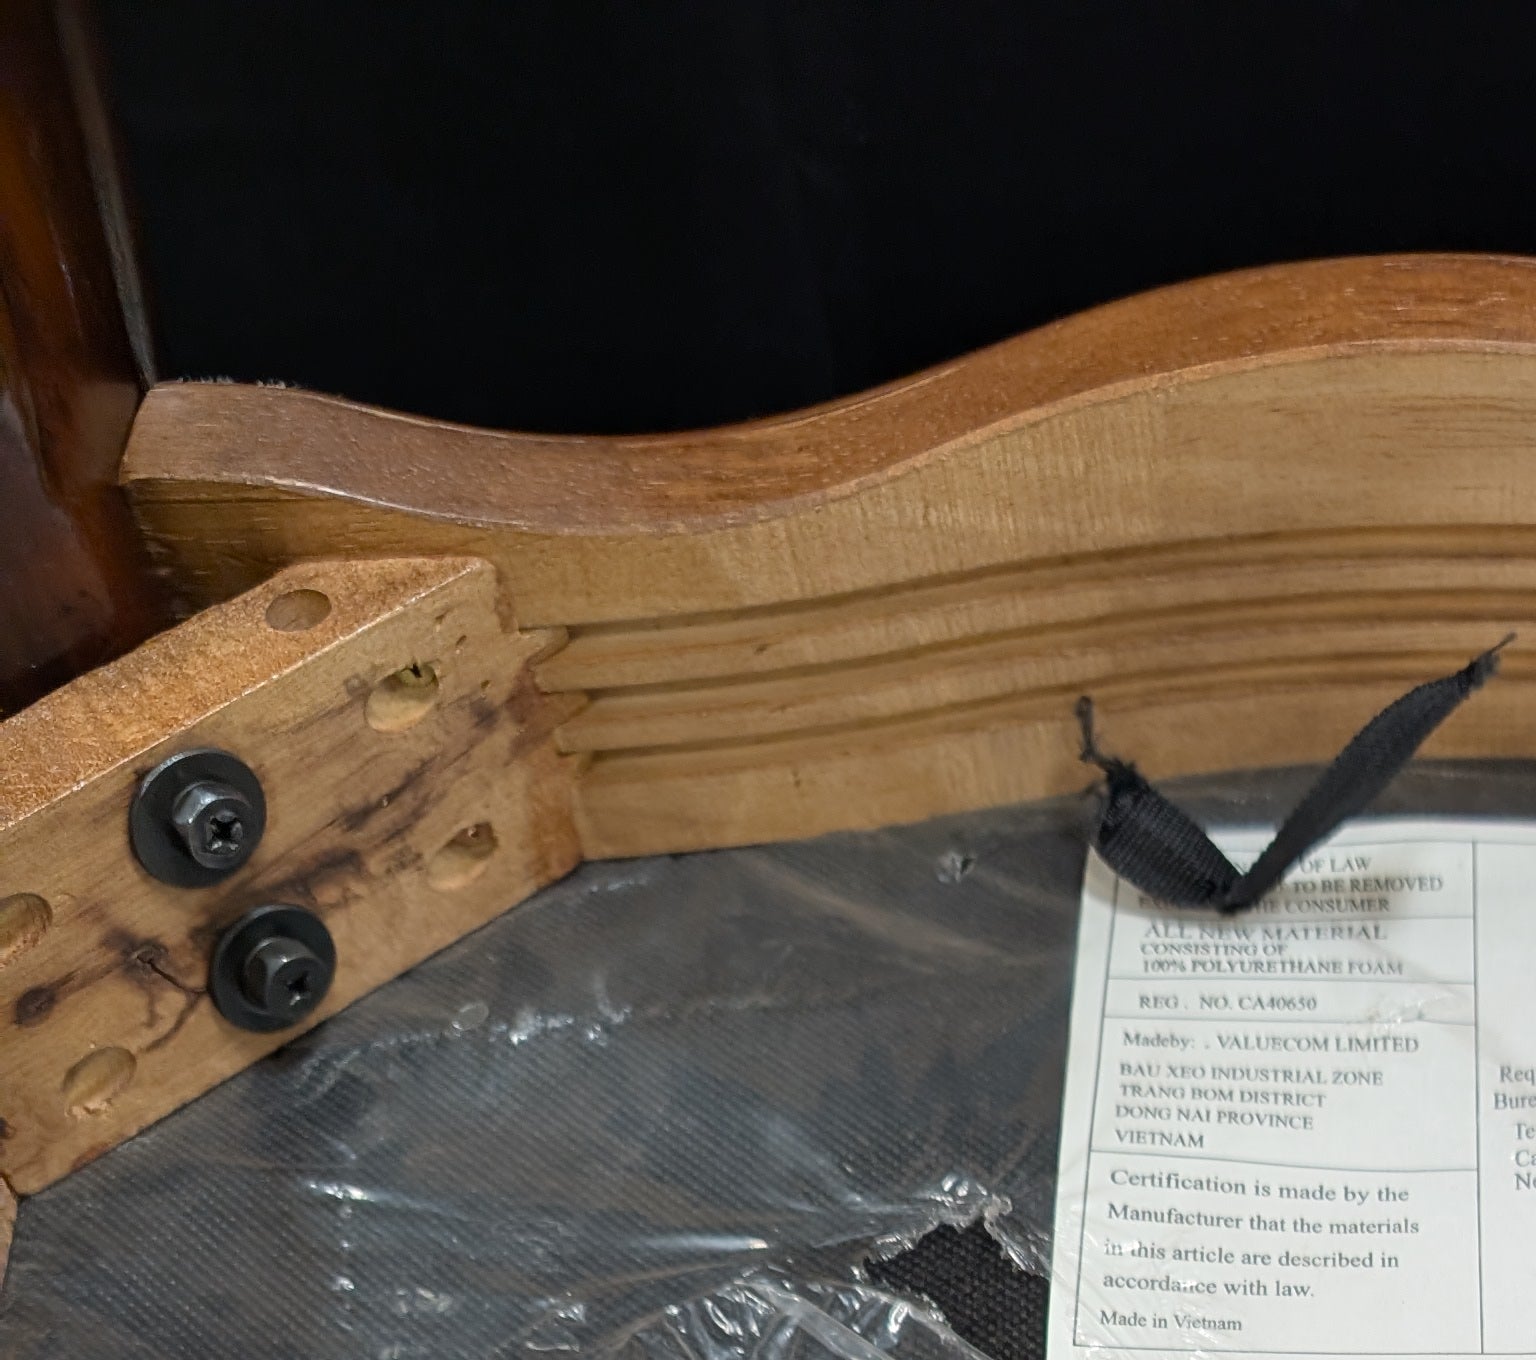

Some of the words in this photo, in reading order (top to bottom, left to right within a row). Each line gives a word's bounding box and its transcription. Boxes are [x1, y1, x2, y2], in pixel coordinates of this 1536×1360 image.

[1301, 858, 1324, 873] OF
[1330, 857, 1369, 872] LAW
[1291, 881, 1317, 896] TO
[1321, 879, 1344, 894] BE
[1350, 875, 1443, 893] REMOVED
[1285, 895, 1389, 913] CONSUMER
[1145, 922, 1192, 939] ALL
[1199, 924, 1253, 942] NEW
[1262, 923, 1386, 941] MATERIAL
[1140, 942, 1257, 956] CONSISTING
[1263, 943, 1288, 956] OF
[1144, 958, 1186, 973] 100%
[1191, 958, 1342, 974] POLYURETHANE
[1348, 960, 1403, 975] FOAM
[1200, 995, 1235, 1009] NO.
[1123, 1030, 1196, 1051] Madeby:
[1217, 1034, 1329, 1052] VALUECOM
[1335, 1034, 1419, 1052] LIMITED
[1120, 1062, 1160, 1077] BAU
[1167, 1065, 1206, 1079] XEO
[1211, 1066, 1327, 1084] INDUSTRIAL
[1332, 1070, 1383, 1085] ZONE
[1120, 1083, 1185, 1099] TRANG
[1191, 1087, 1233, 1102] BOM
[1240, 1090, 1326, 1107] DISTRICT
[1116, 1104, 1171, 1120] DONG
[1177, 1108, 1210, 1122] NAI
[1217, 1110, 1312, 1129] PROVINCE
[1115, 1129, 1204, 1148] VIETNAM
[1111, 1170, 1245, 1195] Certification
[1255, 1180, 1270, 1196] is
[1279, 1185, 1336, 1201] made
[1344, 1186, 1369, 1205] by
[1378, 1187, 1408, 1201] the
[1108, 1202, 1243, 1229] Manufacturer
[1250, 1214, 1285, 1232] that
[1293, 1218, 1322, 1233] the
[1329, 1218, 1419, 1234] materials
[1104, 1237, 1123, 1256] in
[1131, 1241, 1165, 1260] this
[1172, 1246, 1234, 1264] article
[1241, 1254, 1271, 1266] are
[1278, 1251, 1373, 1268] described
[1381, 1252, 1398, 1267] in
[1224, 1280, 1267, 1296] with
[1276, 1280, 1313, 1296] law.
[1100, 1310, 1147, 1327] Made
[1153, 1313, 1167, 1328] in
[1173, 1314, 1242, 1331] Vietnam
